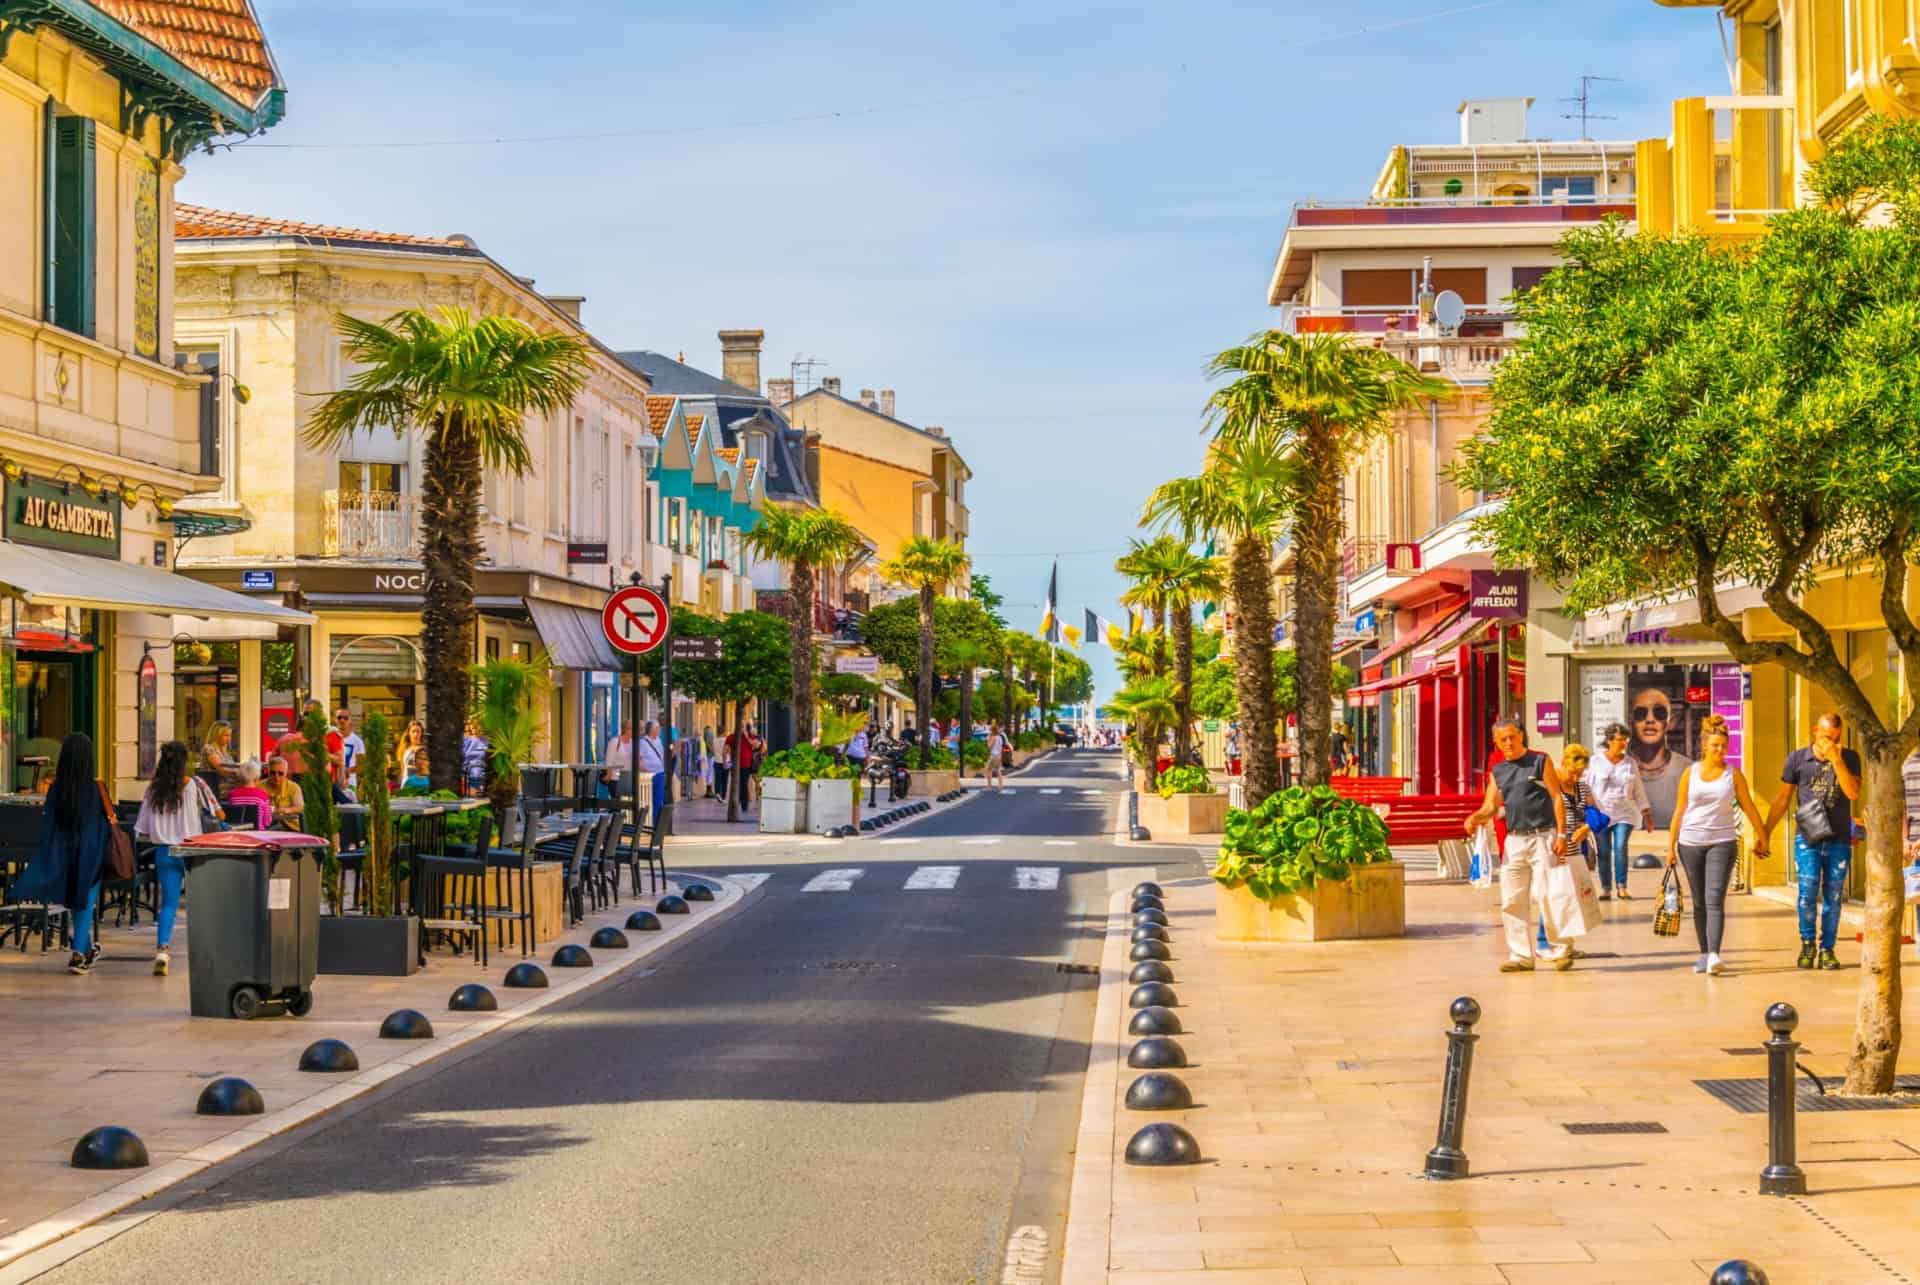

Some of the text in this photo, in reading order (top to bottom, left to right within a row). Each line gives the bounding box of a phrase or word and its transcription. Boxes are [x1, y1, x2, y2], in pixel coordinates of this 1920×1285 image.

[24, 496, 116, 540] AU GAMBETTA
[1488, 585, 1518, 596] ALAIN
[1472, 597, 1518, 608] AFFLELOU
